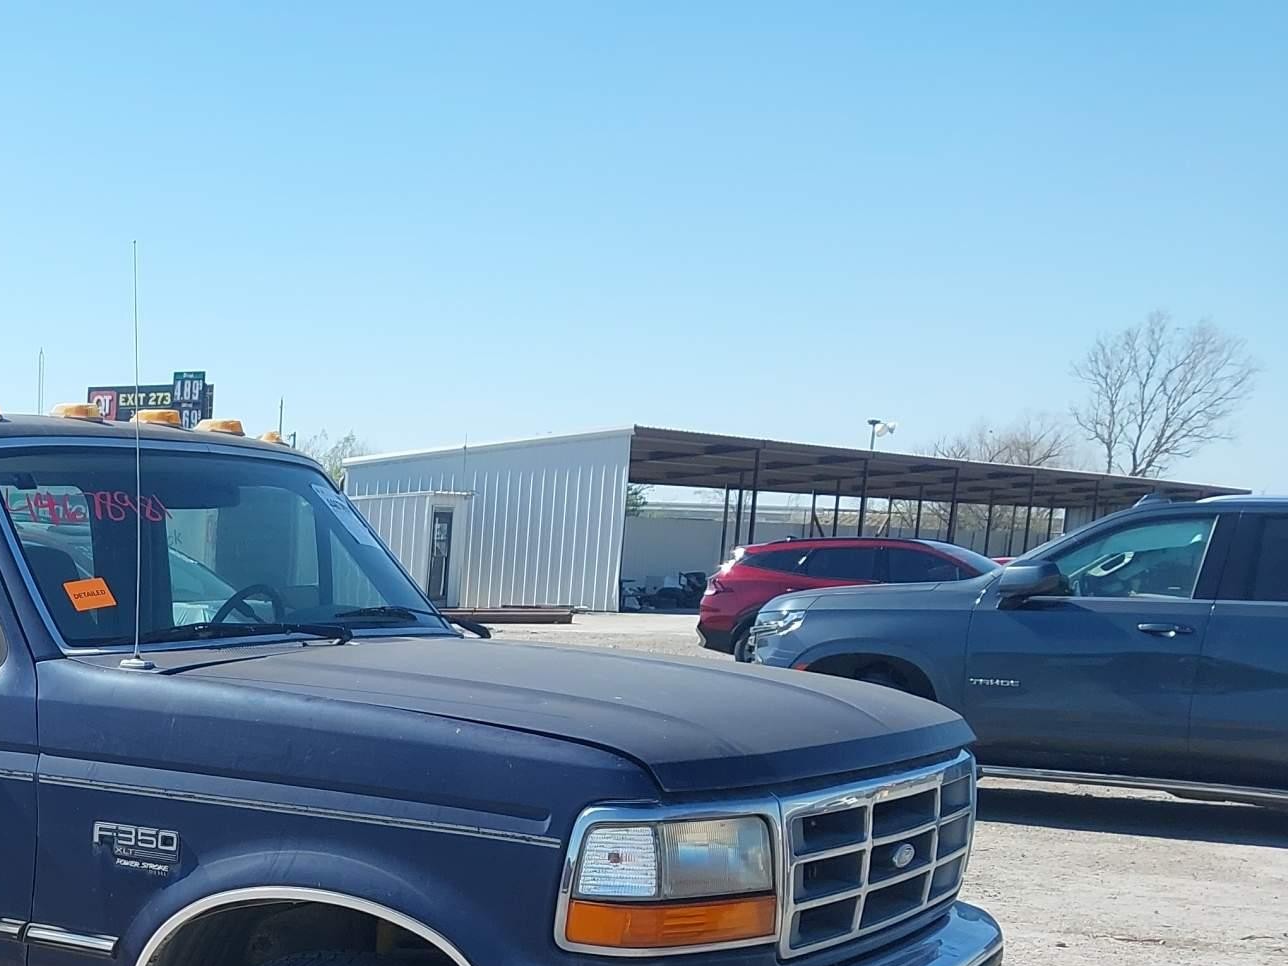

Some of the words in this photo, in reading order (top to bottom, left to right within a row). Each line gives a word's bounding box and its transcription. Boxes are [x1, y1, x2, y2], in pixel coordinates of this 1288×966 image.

[148, 392, 171, 405] 273
[93, 395, 112, 416] QT
[73, 589, 106, 600] DETAILED
[115, 847, 135, 856] XLT
